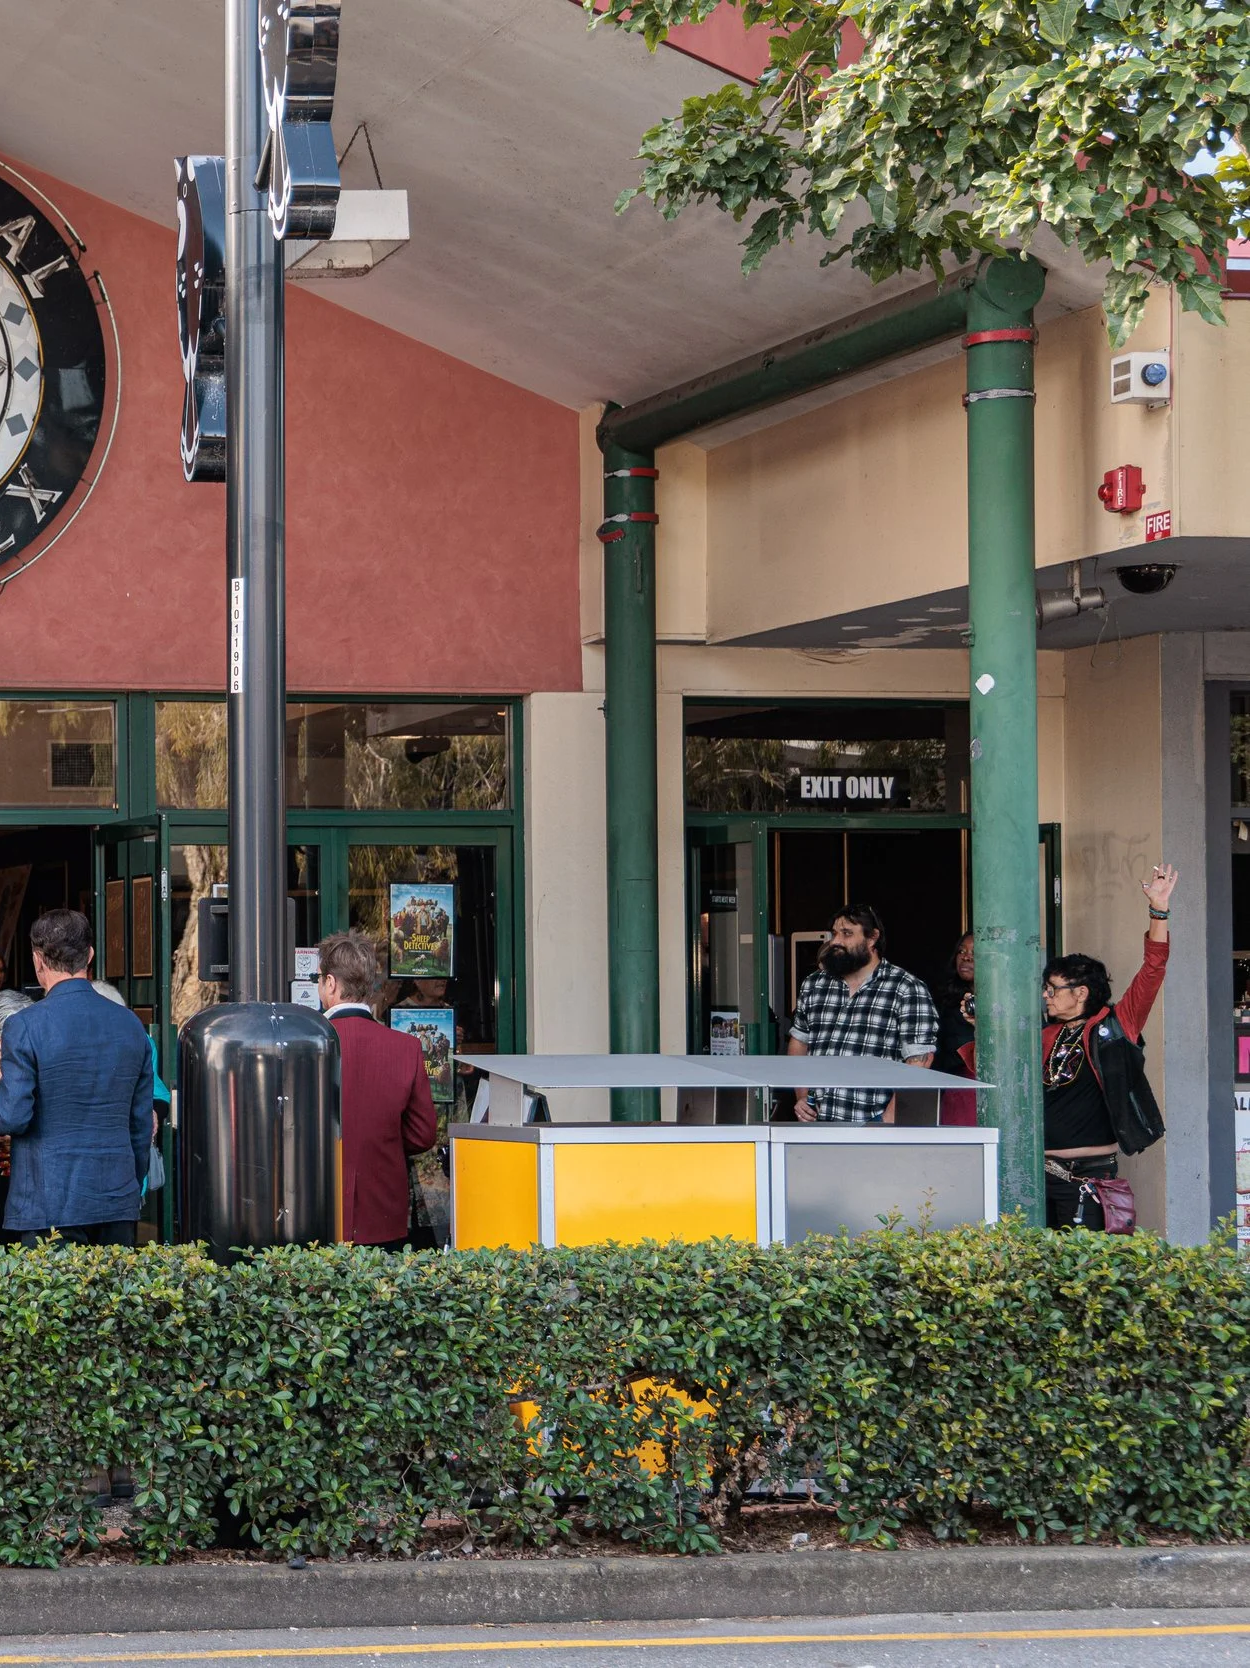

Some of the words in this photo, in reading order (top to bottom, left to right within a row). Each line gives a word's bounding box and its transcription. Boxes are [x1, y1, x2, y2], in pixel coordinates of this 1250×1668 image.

[1146, 512, 1171, 535] FIRE
[232, 580, 241, 692] B1011906
[800, 775, 842, 799] EXIT
[845, 775, 895, 799] ONLY
[403, 940, 438, 951] DETECTIVES
[411, 933, 431, 943] SHEEP
